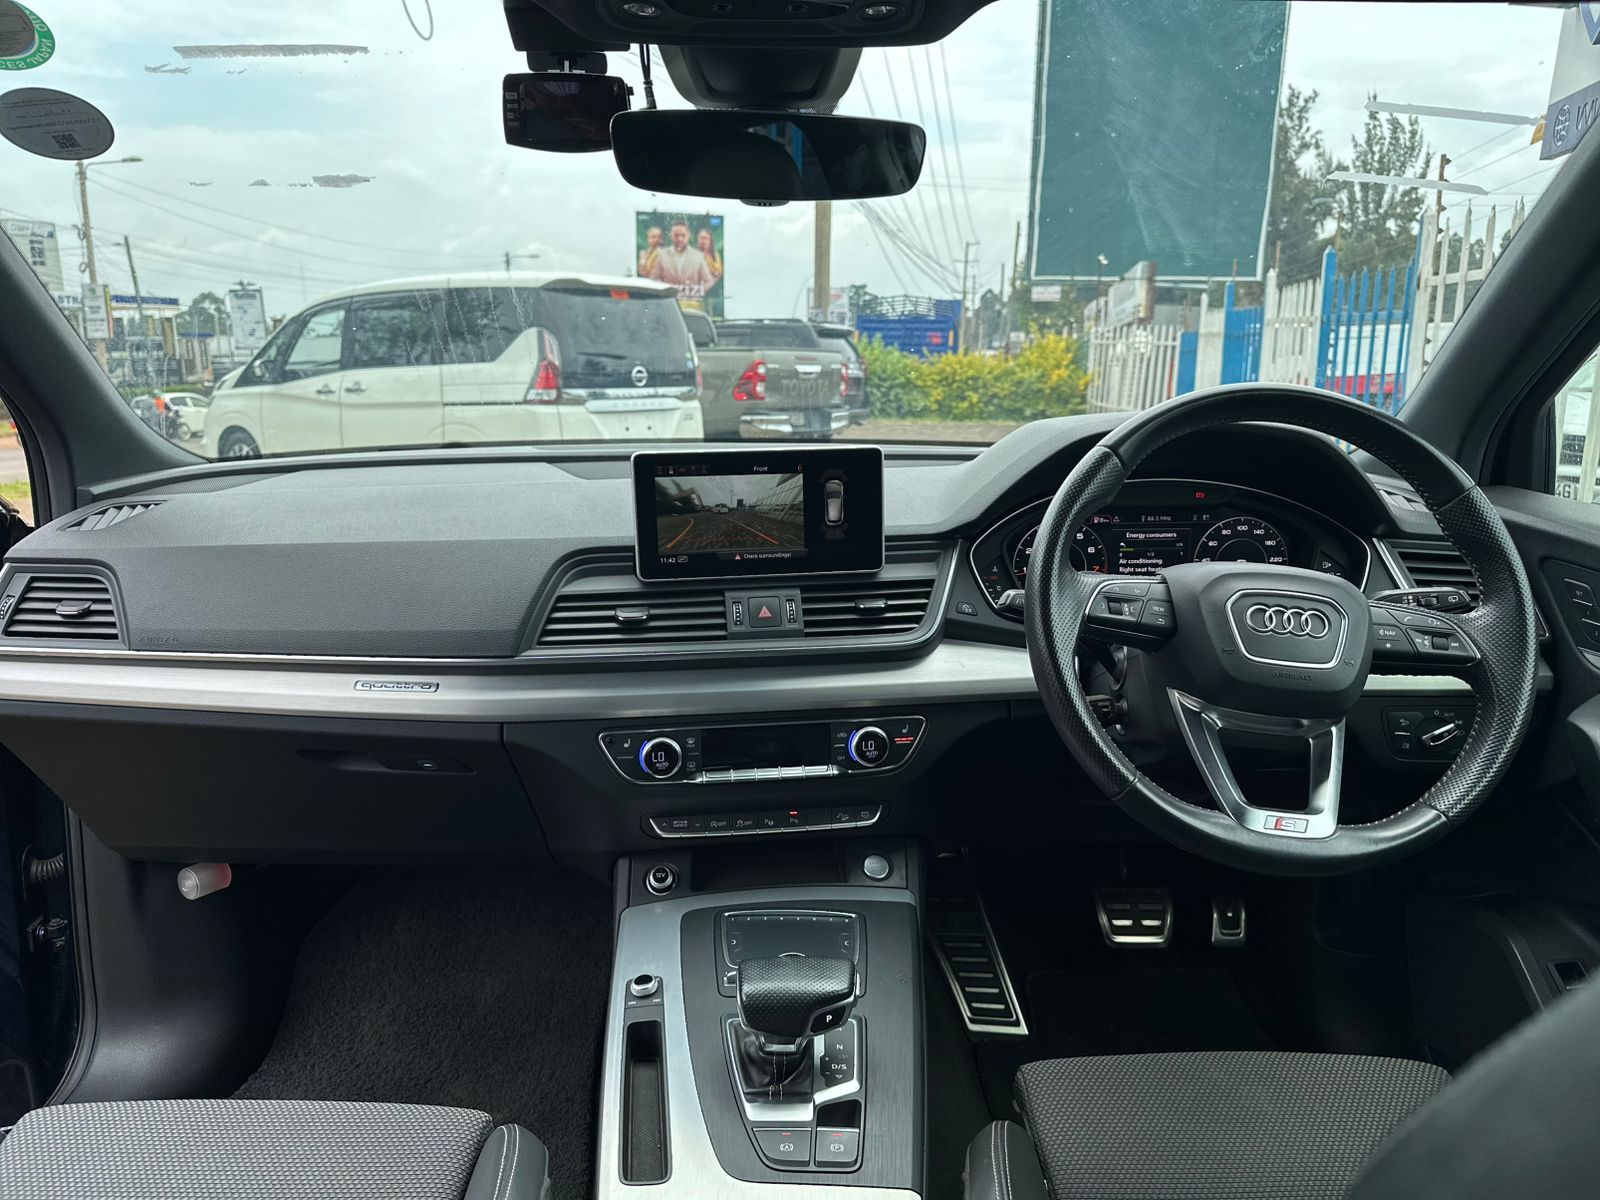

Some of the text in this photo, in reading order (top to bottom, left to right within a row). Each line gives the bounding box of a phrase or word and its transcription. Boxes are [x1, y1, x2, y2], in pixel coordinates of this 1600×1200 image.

[782, 379, 830, 397] TOYOTA
[759, 551, 792, 560] surroundings!
[1272, 671, 1313, 681] AIRBAG
[361, 682, 432, 690] quattro
[826, 1014, 833, 1023] P
[836, 1043, 844, 1051] N
